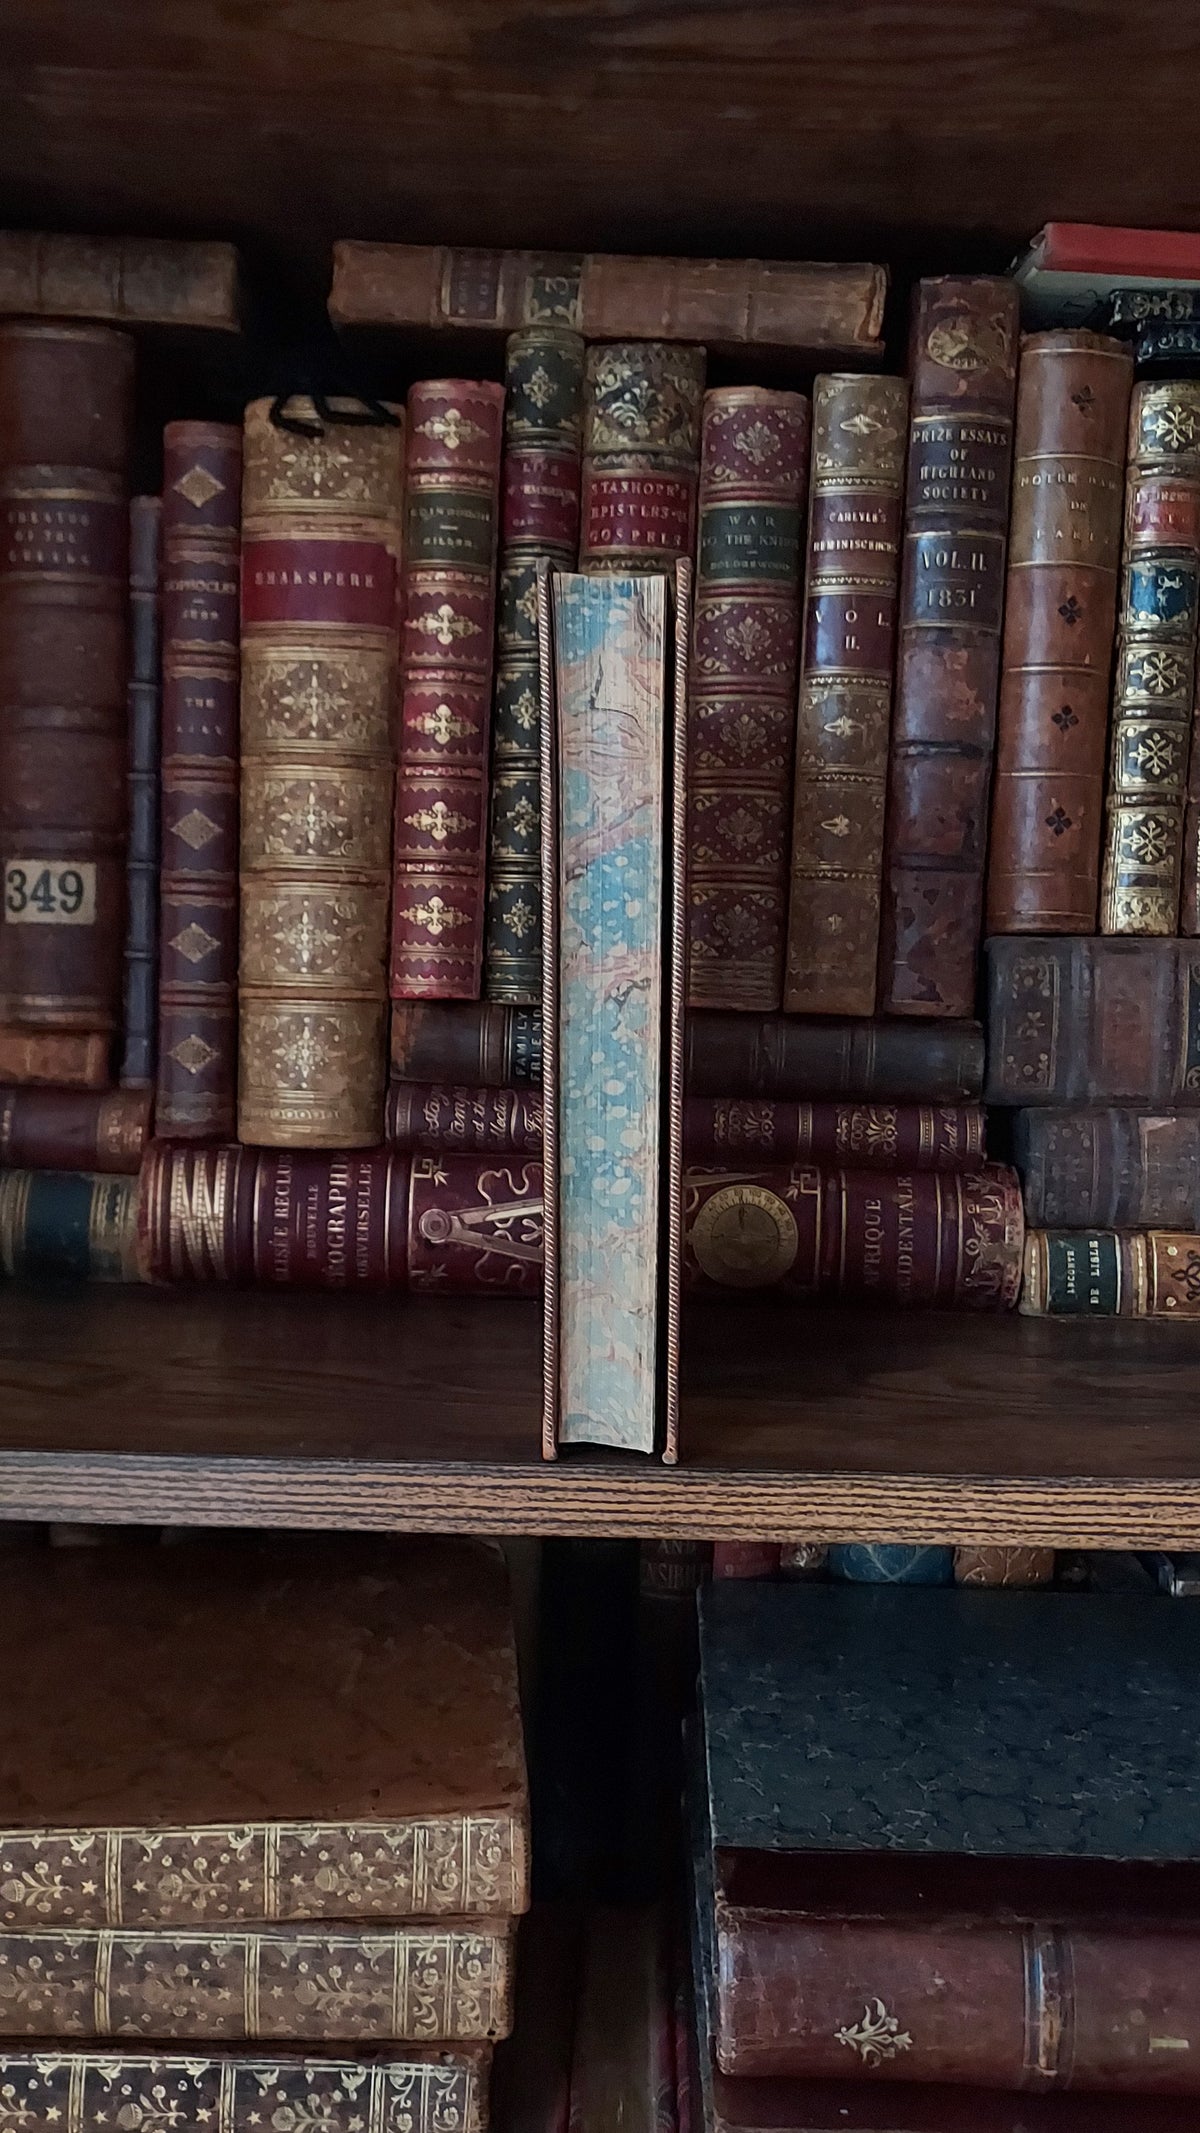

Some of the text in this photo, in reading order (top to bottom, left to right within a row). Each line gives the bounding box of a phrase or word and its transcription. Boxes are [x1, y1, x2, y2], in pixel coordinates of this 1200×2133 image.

[911, 427, 1008, 447] PRIZE ESSAYS
[949, 449, 970, 462] OF
[919, 466, 997, 482] HIGHLAND
[1087, 476, 1117, 490] DAM
[921, 486, 989, 502] SOCIETY
[728, 514, 776, 529] WAR
[828, 506, 888, 524] CARLYLE'S
[589, 528, 682, 547] GOSPELS
[725, 534, 753, 546] THE
[1035, 529, 1110, 545] PARI
[922, 550, 968, 571] VOL.
[925, 587, 977, 608] 1831
[814, 608, 891, 627] VOL.
[844, 635, 861, 651] II.
[6, 867, 84, 915] 349
[515, 1010, 530, 1077] FAMILY
[530, 1008, 543, 1083] FRIEND
[421, 1085, 450, 1142] ostag
[306, 1184, 319, 1259] NOUVELLE
[325, 1154, 350, 1283] ÉOGRAPHI
[356, 1163, 374, 1279] UNIVERSELLE
[897, 1176, 914, 1296] CIDENTALE
[1065, 1250, 1076, 1294] LECONTE
[1088, 1240, 1101, 1304] DE LISLE
